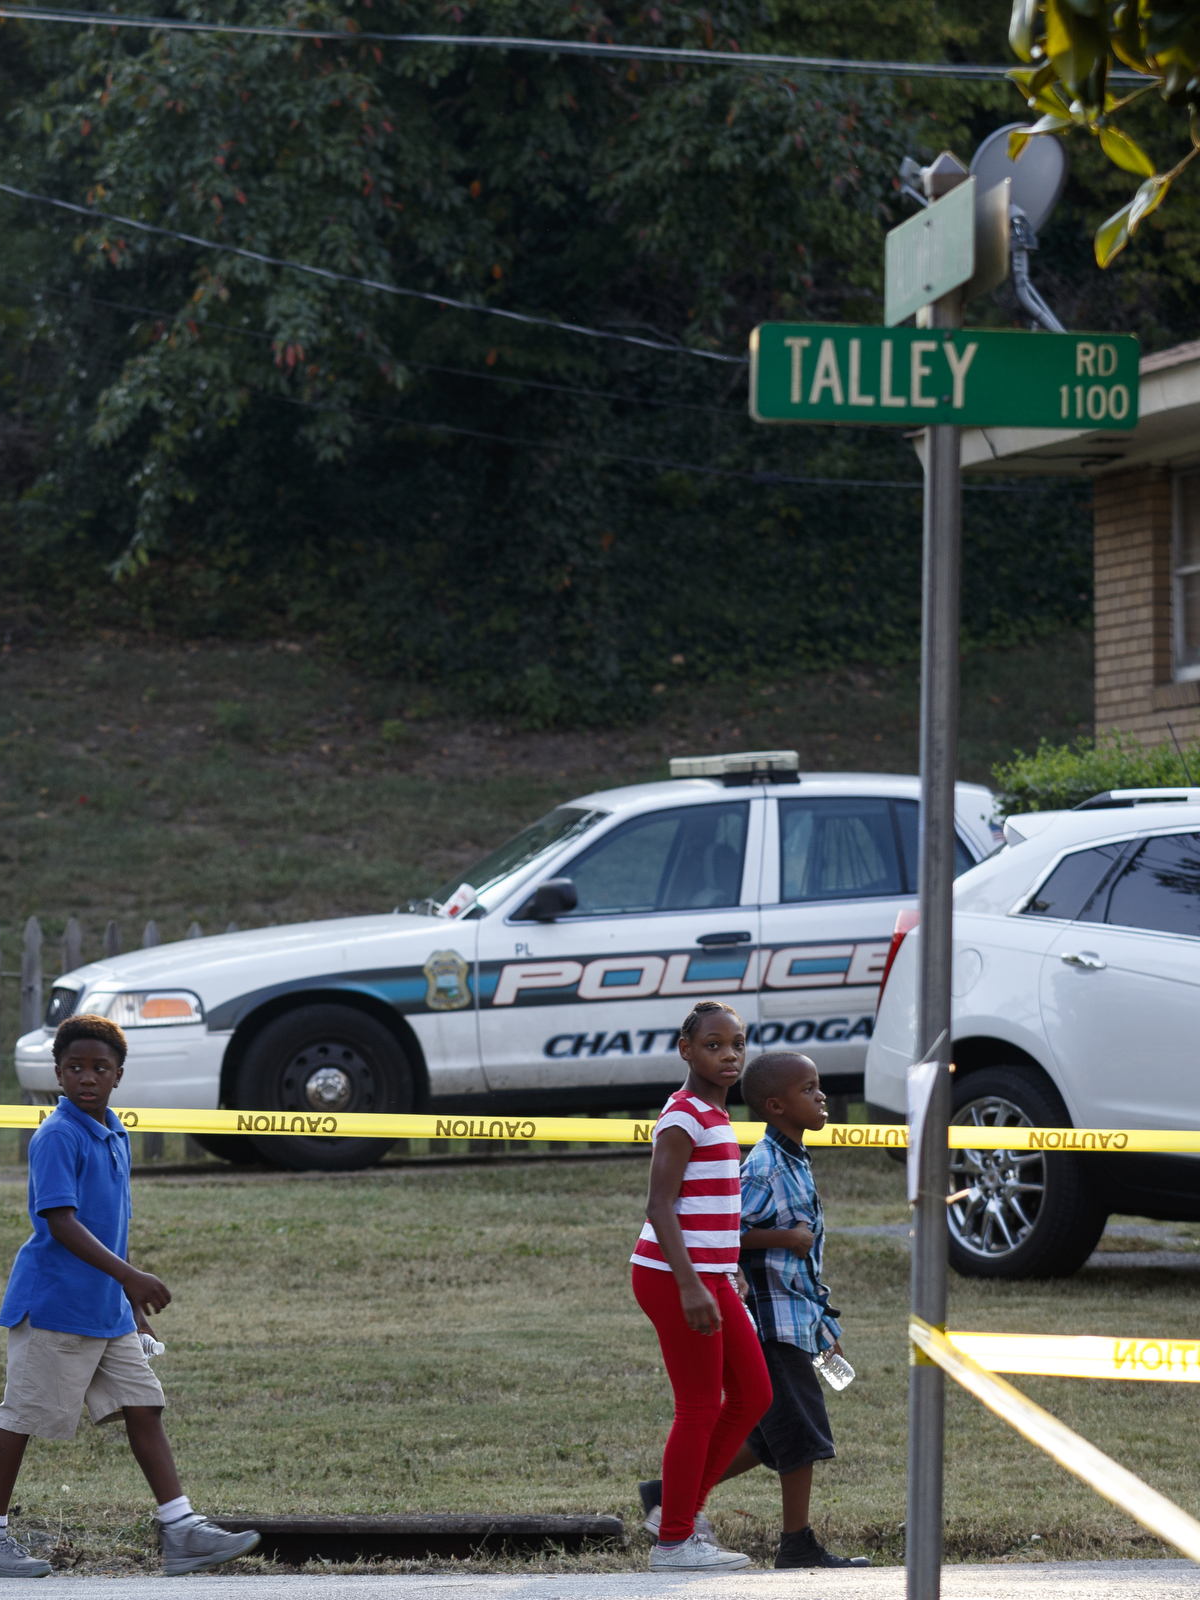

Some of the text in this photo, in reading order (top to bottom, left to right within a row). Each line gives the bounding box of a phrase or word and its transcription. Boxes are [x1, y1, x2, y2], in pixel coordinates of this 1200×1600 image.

[784, 336, 1118, 409] TALLEY RD
[1060, 384, 1130, 420] 1100
[515, 942, 534, 956] PL
[492, 942, 891, 1006] POLICE
[543, 1015, 875, 1059] CHATTOOGA
[237, 1114, 338, 1133] CAUTION
[435, 1119, 536, 1138] CAUTION
[1028, 1131, 1129, 1149] CAUTION
